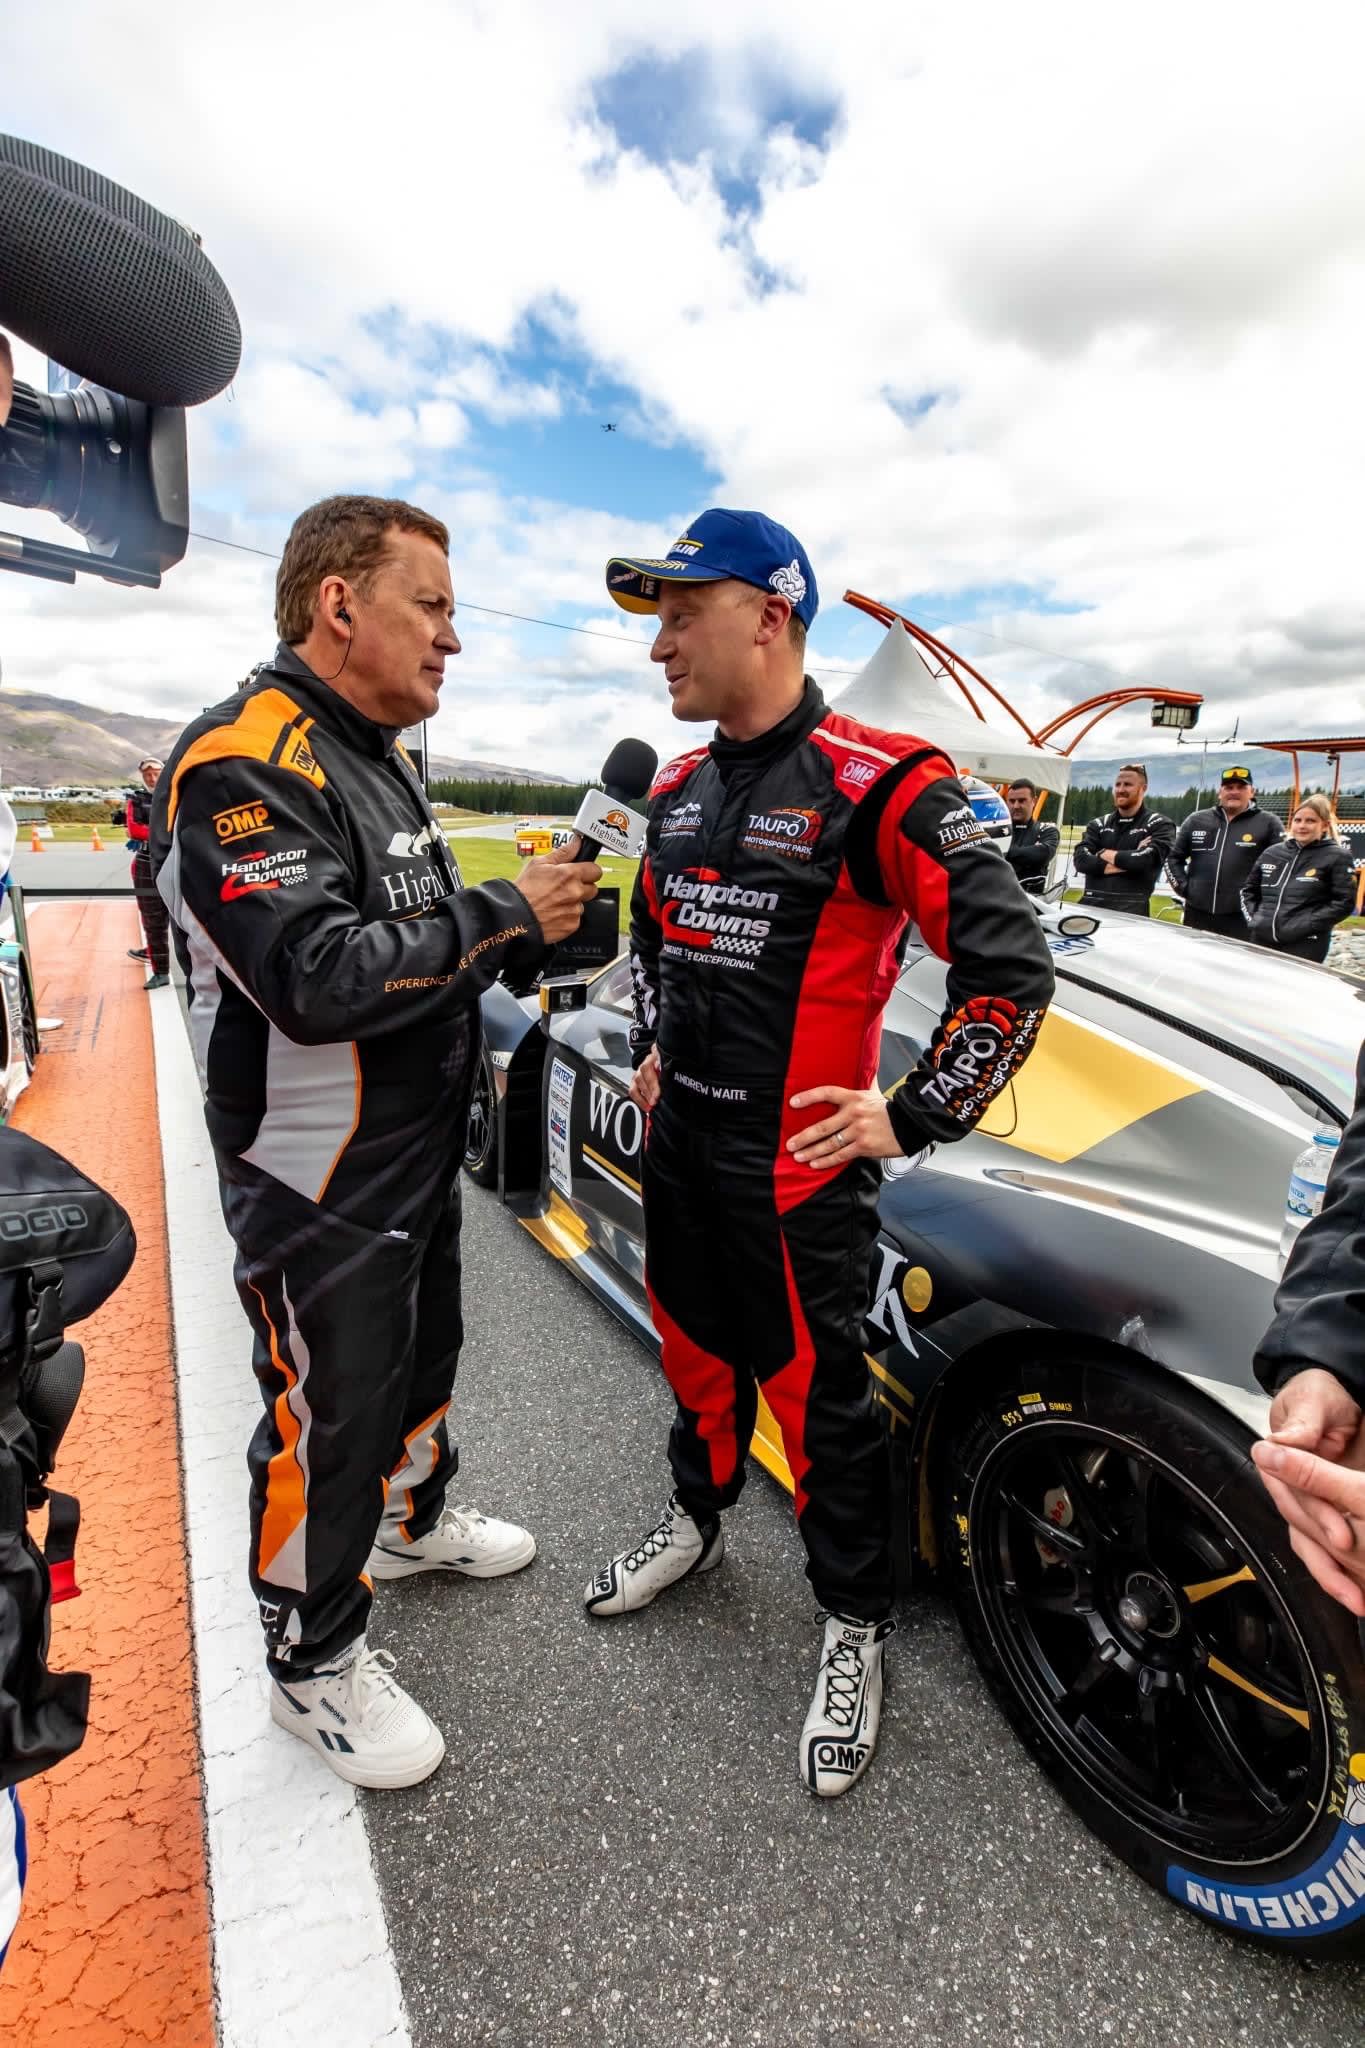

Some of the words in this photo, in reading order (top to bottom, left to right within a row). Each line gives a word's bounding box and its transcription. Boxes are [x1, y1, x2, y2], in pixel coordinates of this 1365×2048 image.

[843, 761, 876, 783] OMP
[216, 806, 269, 837] OMP
[614, 814, 624, 825] 10
[589, 822, 629, 851] Highlands
[744, 835, 791, 850] MOTORSPORT
[791, 844, 814, 855] PARK
[222, 849, 308, 876] Hampton
[244, 864, 308, 883] Downs
[677, 902, 771, 937] Downs
[693, 951, 756, 970] EXCEPTIONAL
[385, 974, 455, 993] EXPERIENCE
[1014, 1008, 1039, 1046] PARK
[674, 1071, 709, 1095] ANDREW
[711, 1087, 748, 1101] WAITE
[0, 1204, 88, 1240] OGIO
[595, 1565, 610, 1592] MP
[842, 1630, 867, 1643] OMP
[818, 1744, 866, 1771] OMP
[1186, 1835, 1365, 1929] MICHELIN
